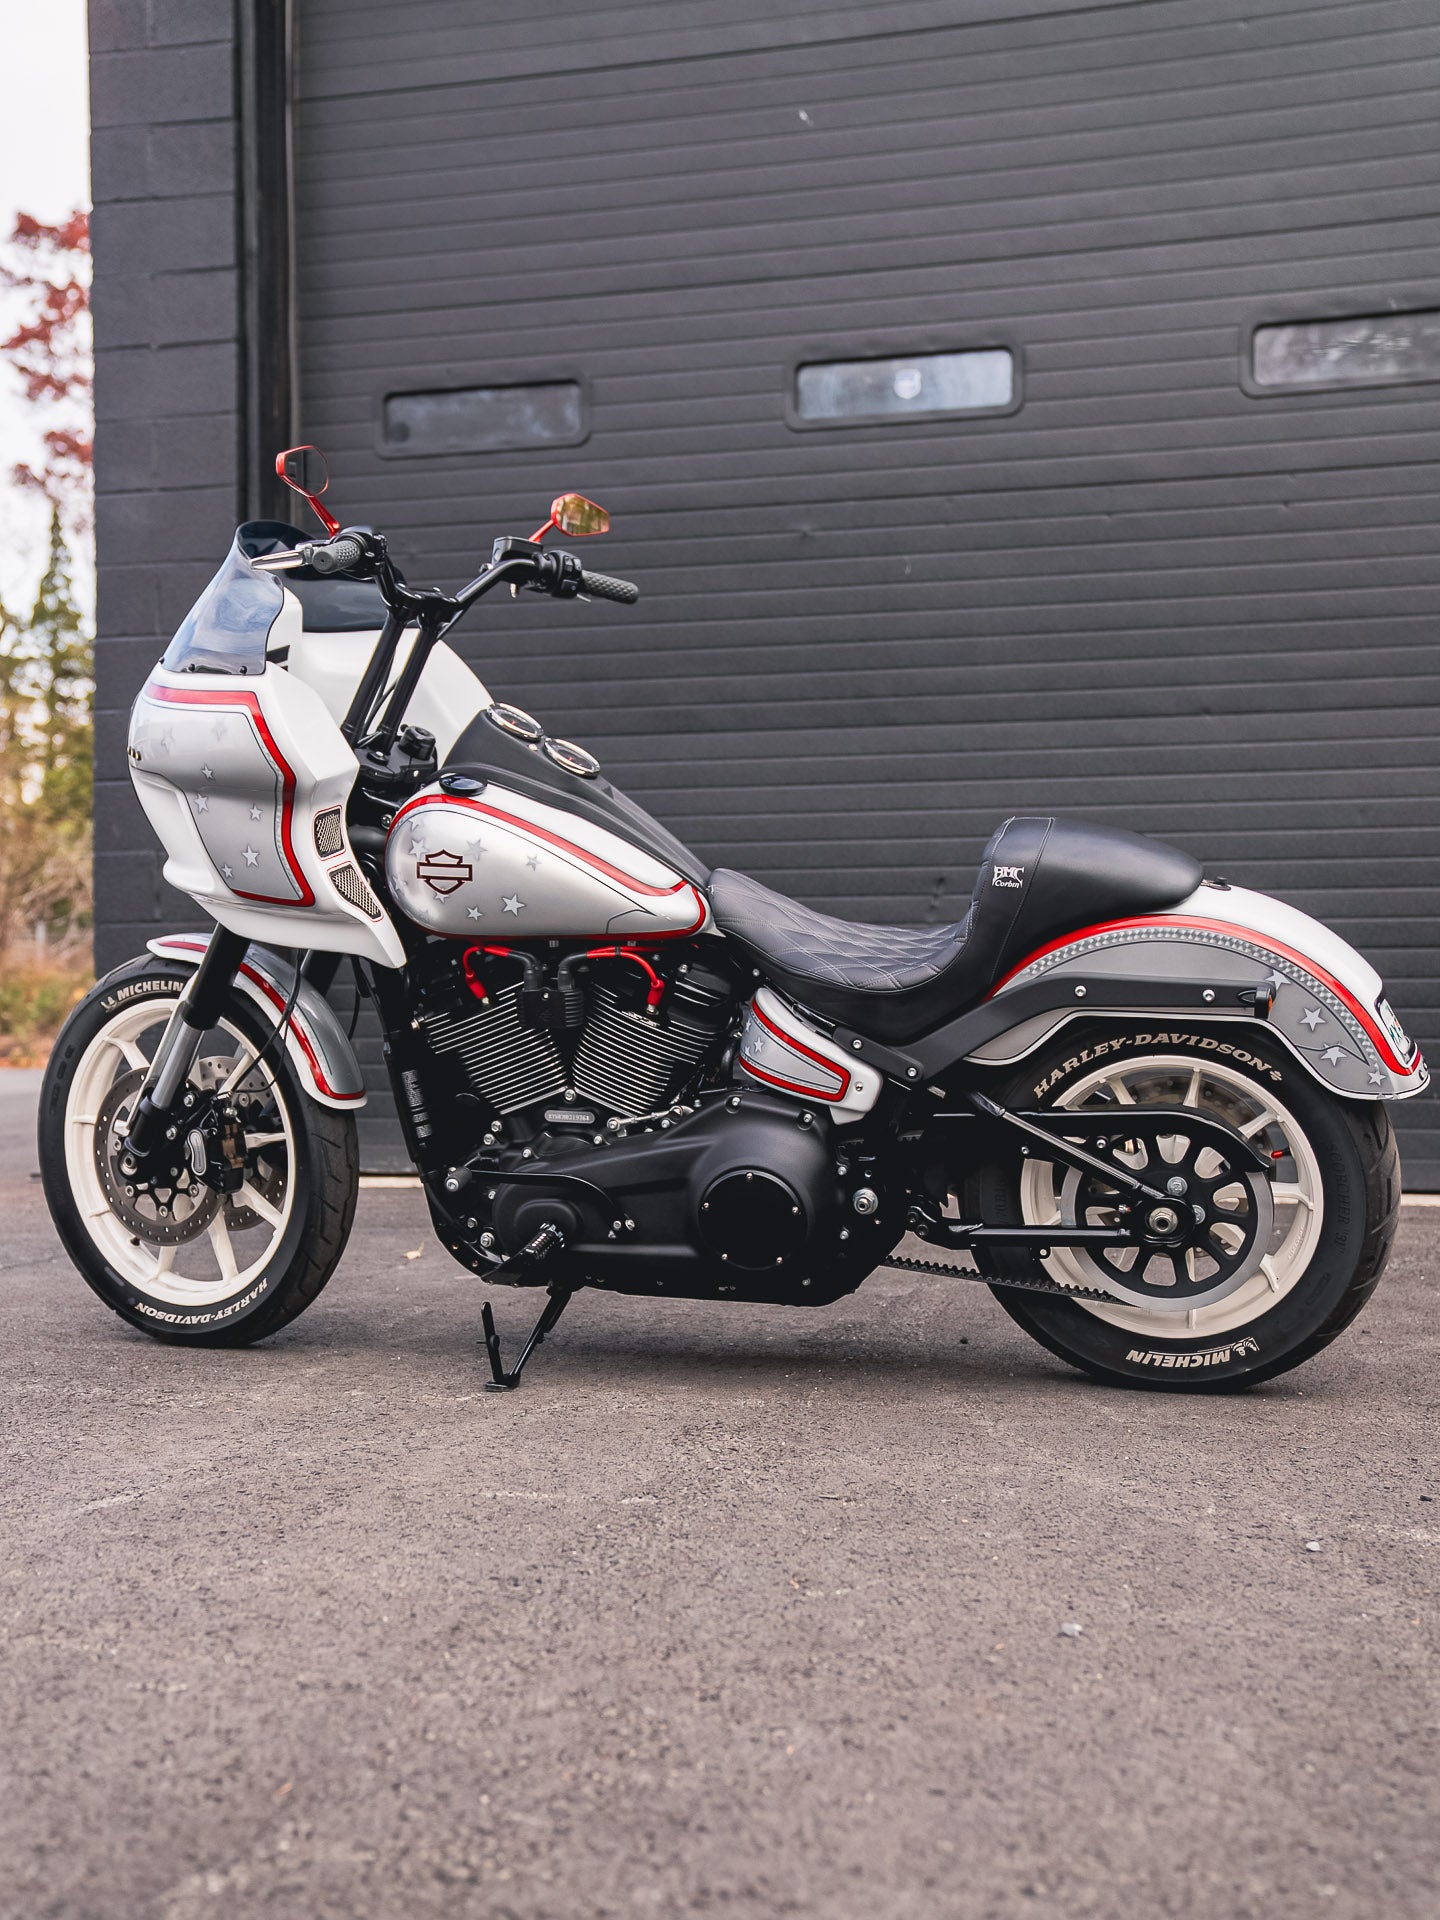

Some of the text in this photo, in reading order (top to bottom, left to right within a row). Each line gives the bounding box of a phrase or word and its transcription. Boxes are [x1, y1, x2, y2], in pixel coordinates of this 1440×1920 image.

[117, 980, 184, 1001] MICHELIN
[1033, 1032, 1272, 1099] HARLEY-DAVIDSON
[134, 1278, 268, 1324] HARLEY-DAVIDSON
[1125, 1349, 1231, 1368] MICHELIN
